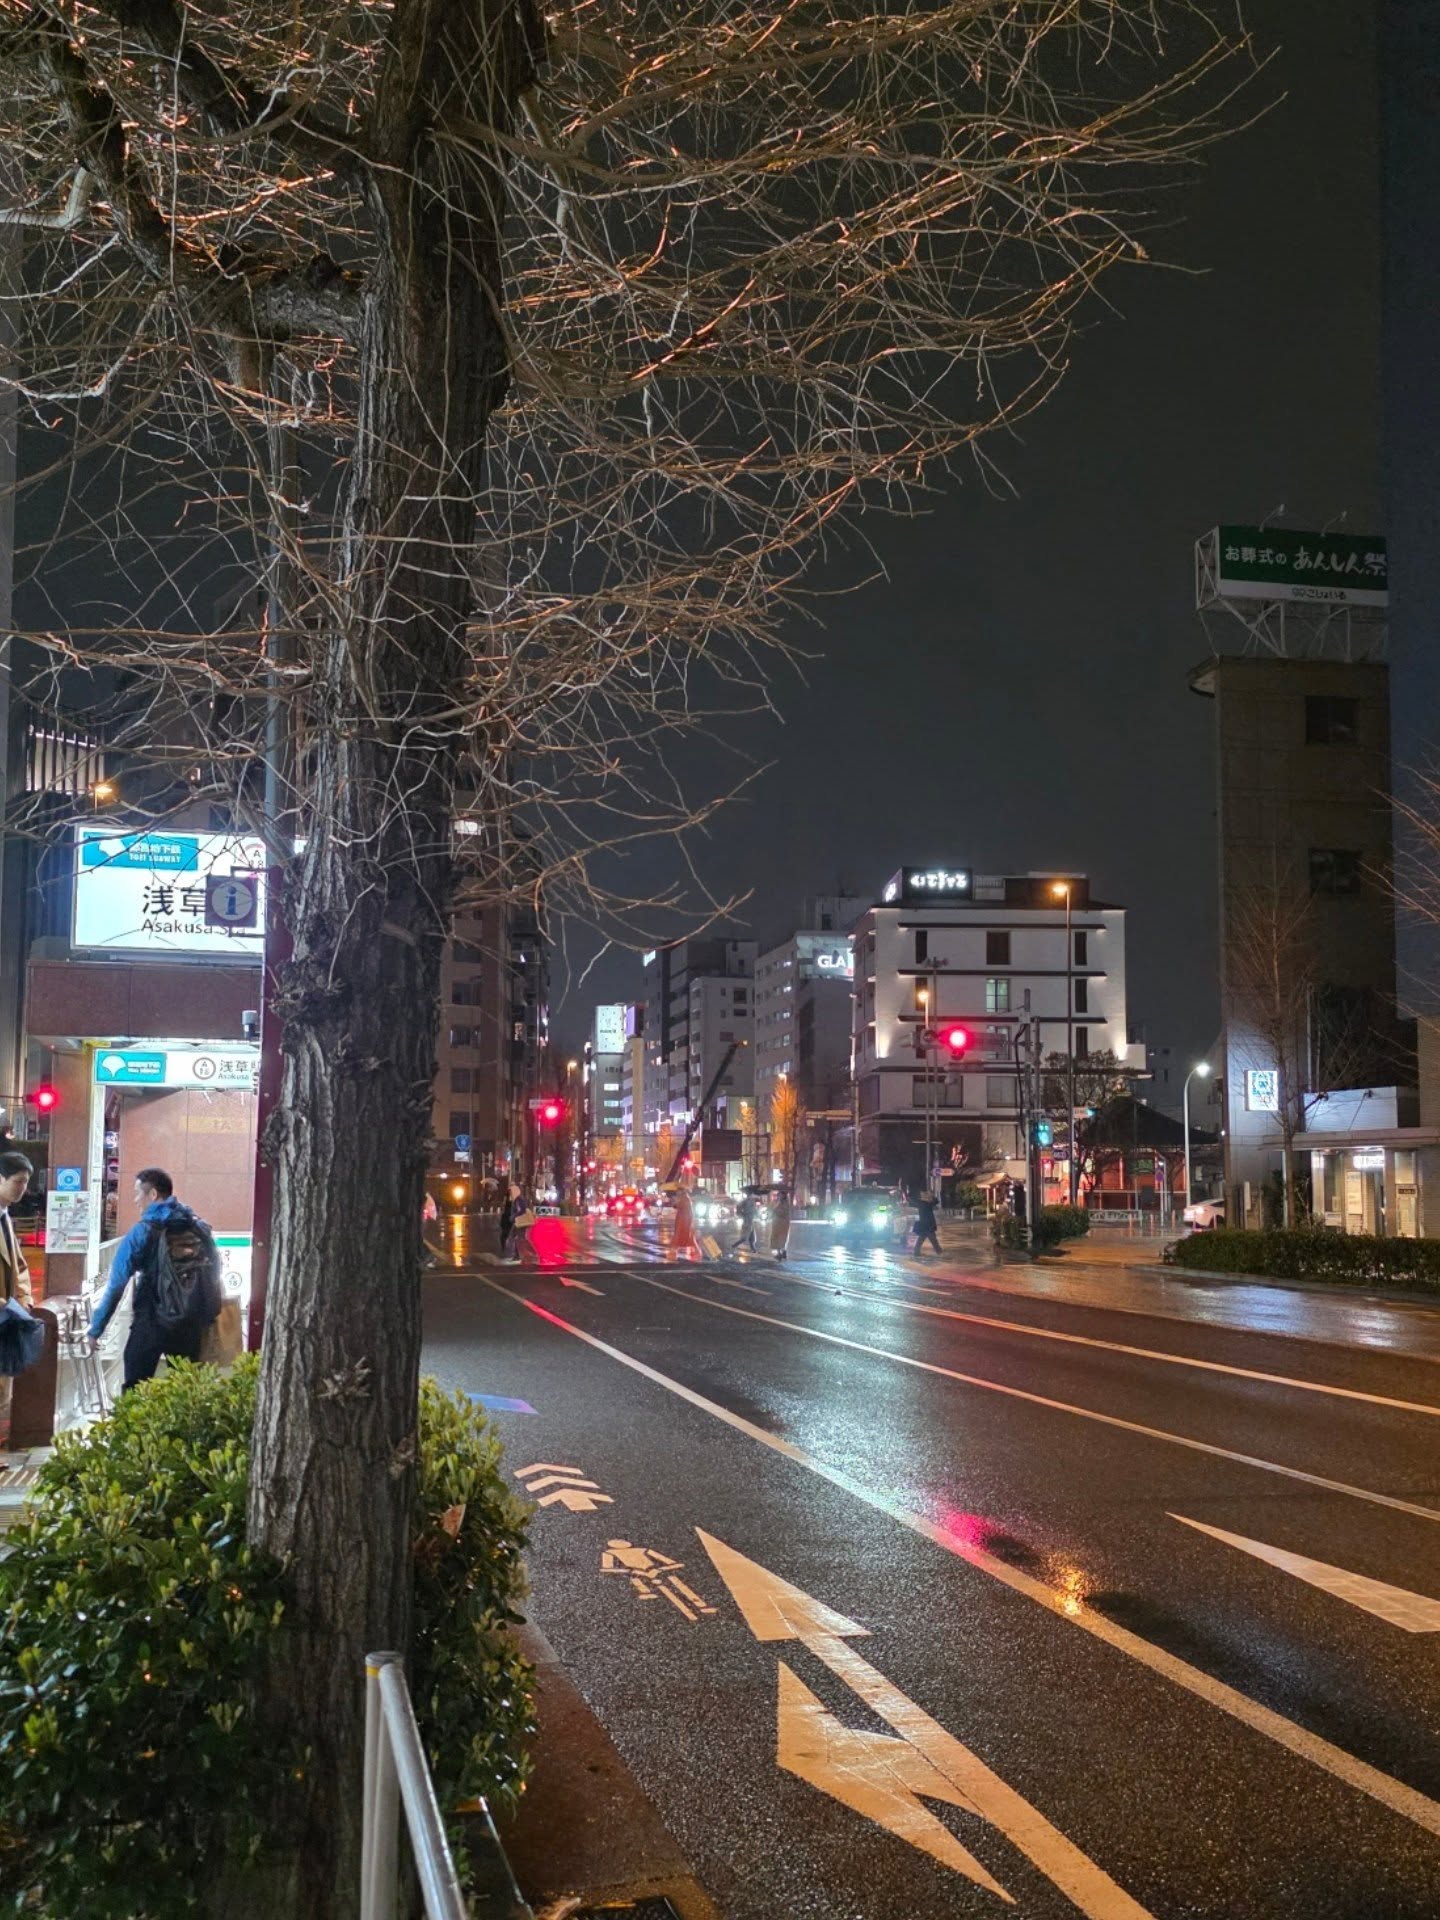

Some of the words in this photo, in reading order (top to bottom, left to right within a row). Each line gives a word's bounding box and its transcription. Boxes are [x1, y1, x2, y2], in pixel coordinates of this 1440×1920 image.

[1225, 546, 1288, 566] お葬式の
[140, 919, 213, 934] Asakusa
